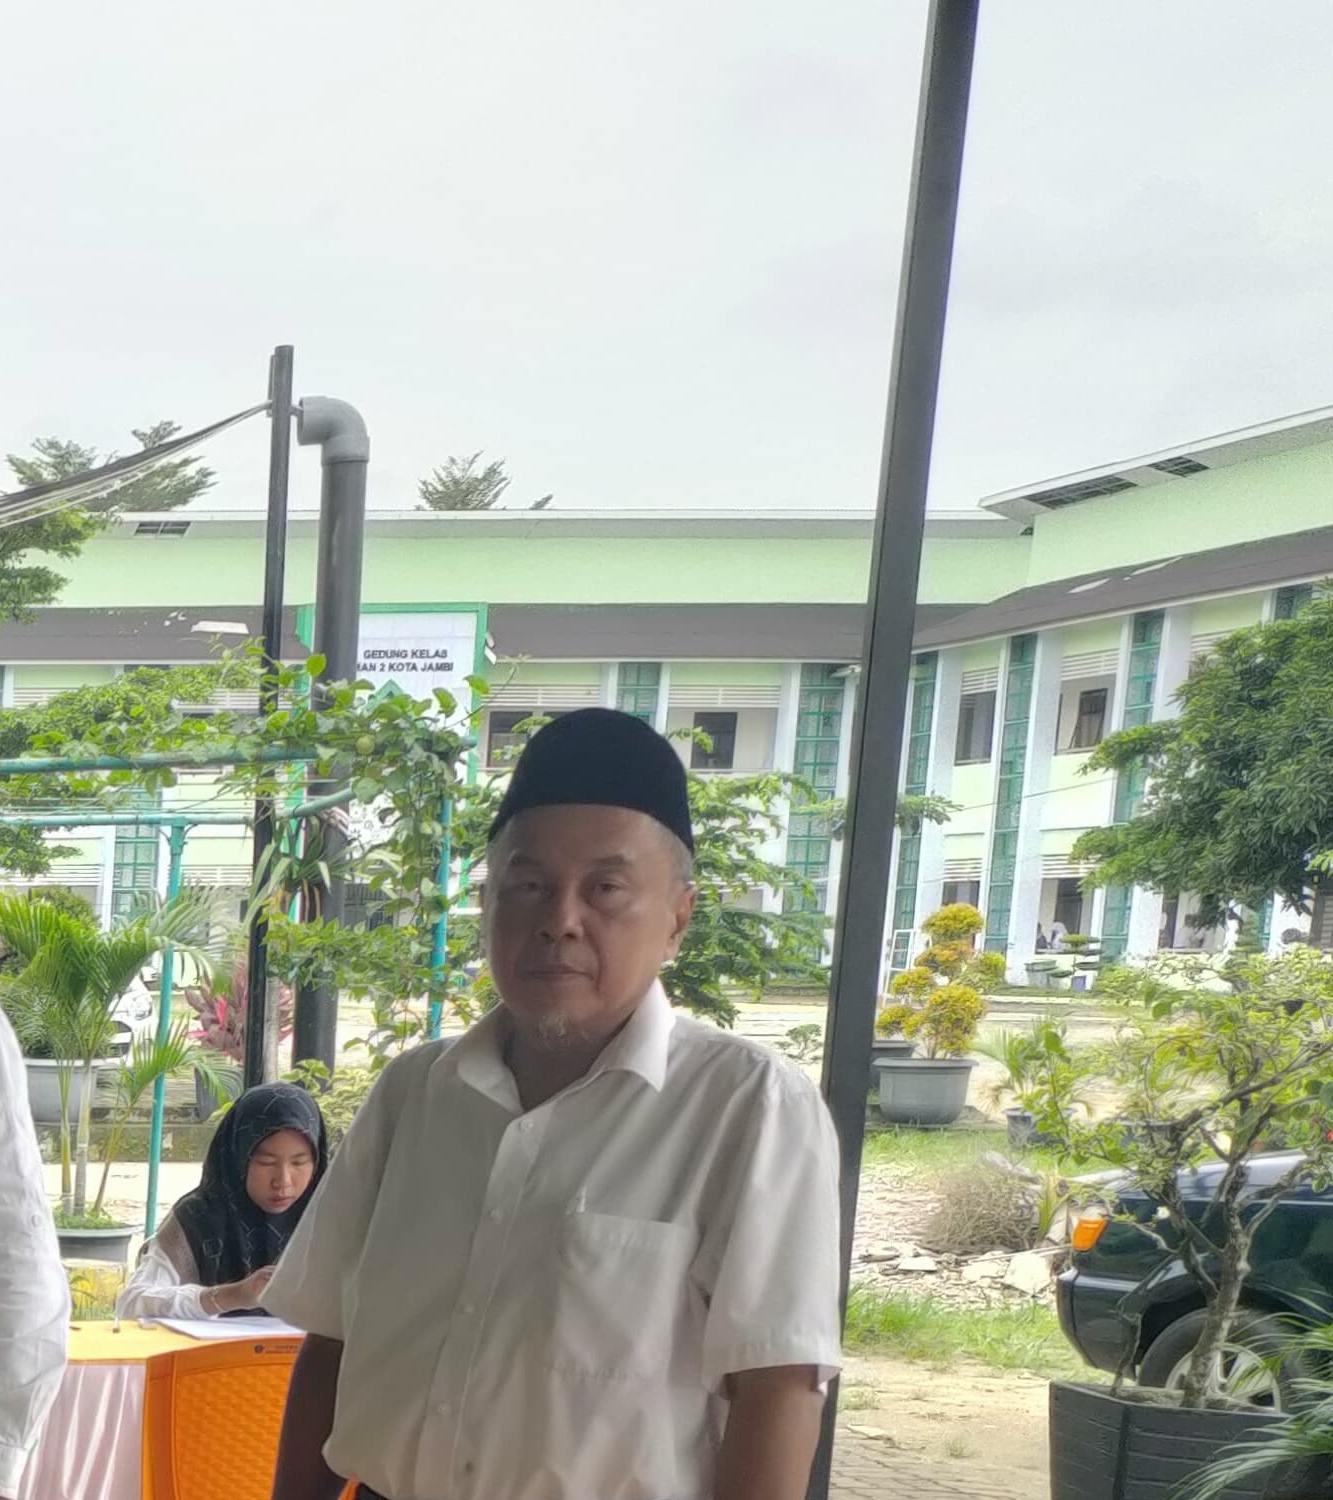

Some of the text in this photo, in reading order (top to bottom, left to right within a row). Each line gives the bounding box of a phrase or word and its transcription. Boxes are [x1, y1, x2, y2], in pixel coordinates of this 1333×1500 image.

[363, 649, 448, 659] GEDUNG KELAS
[379, 662, 386, 672] 2
[388, 662, 418, 672] KOTA
[421, 662, 454, 672] JAMBI
